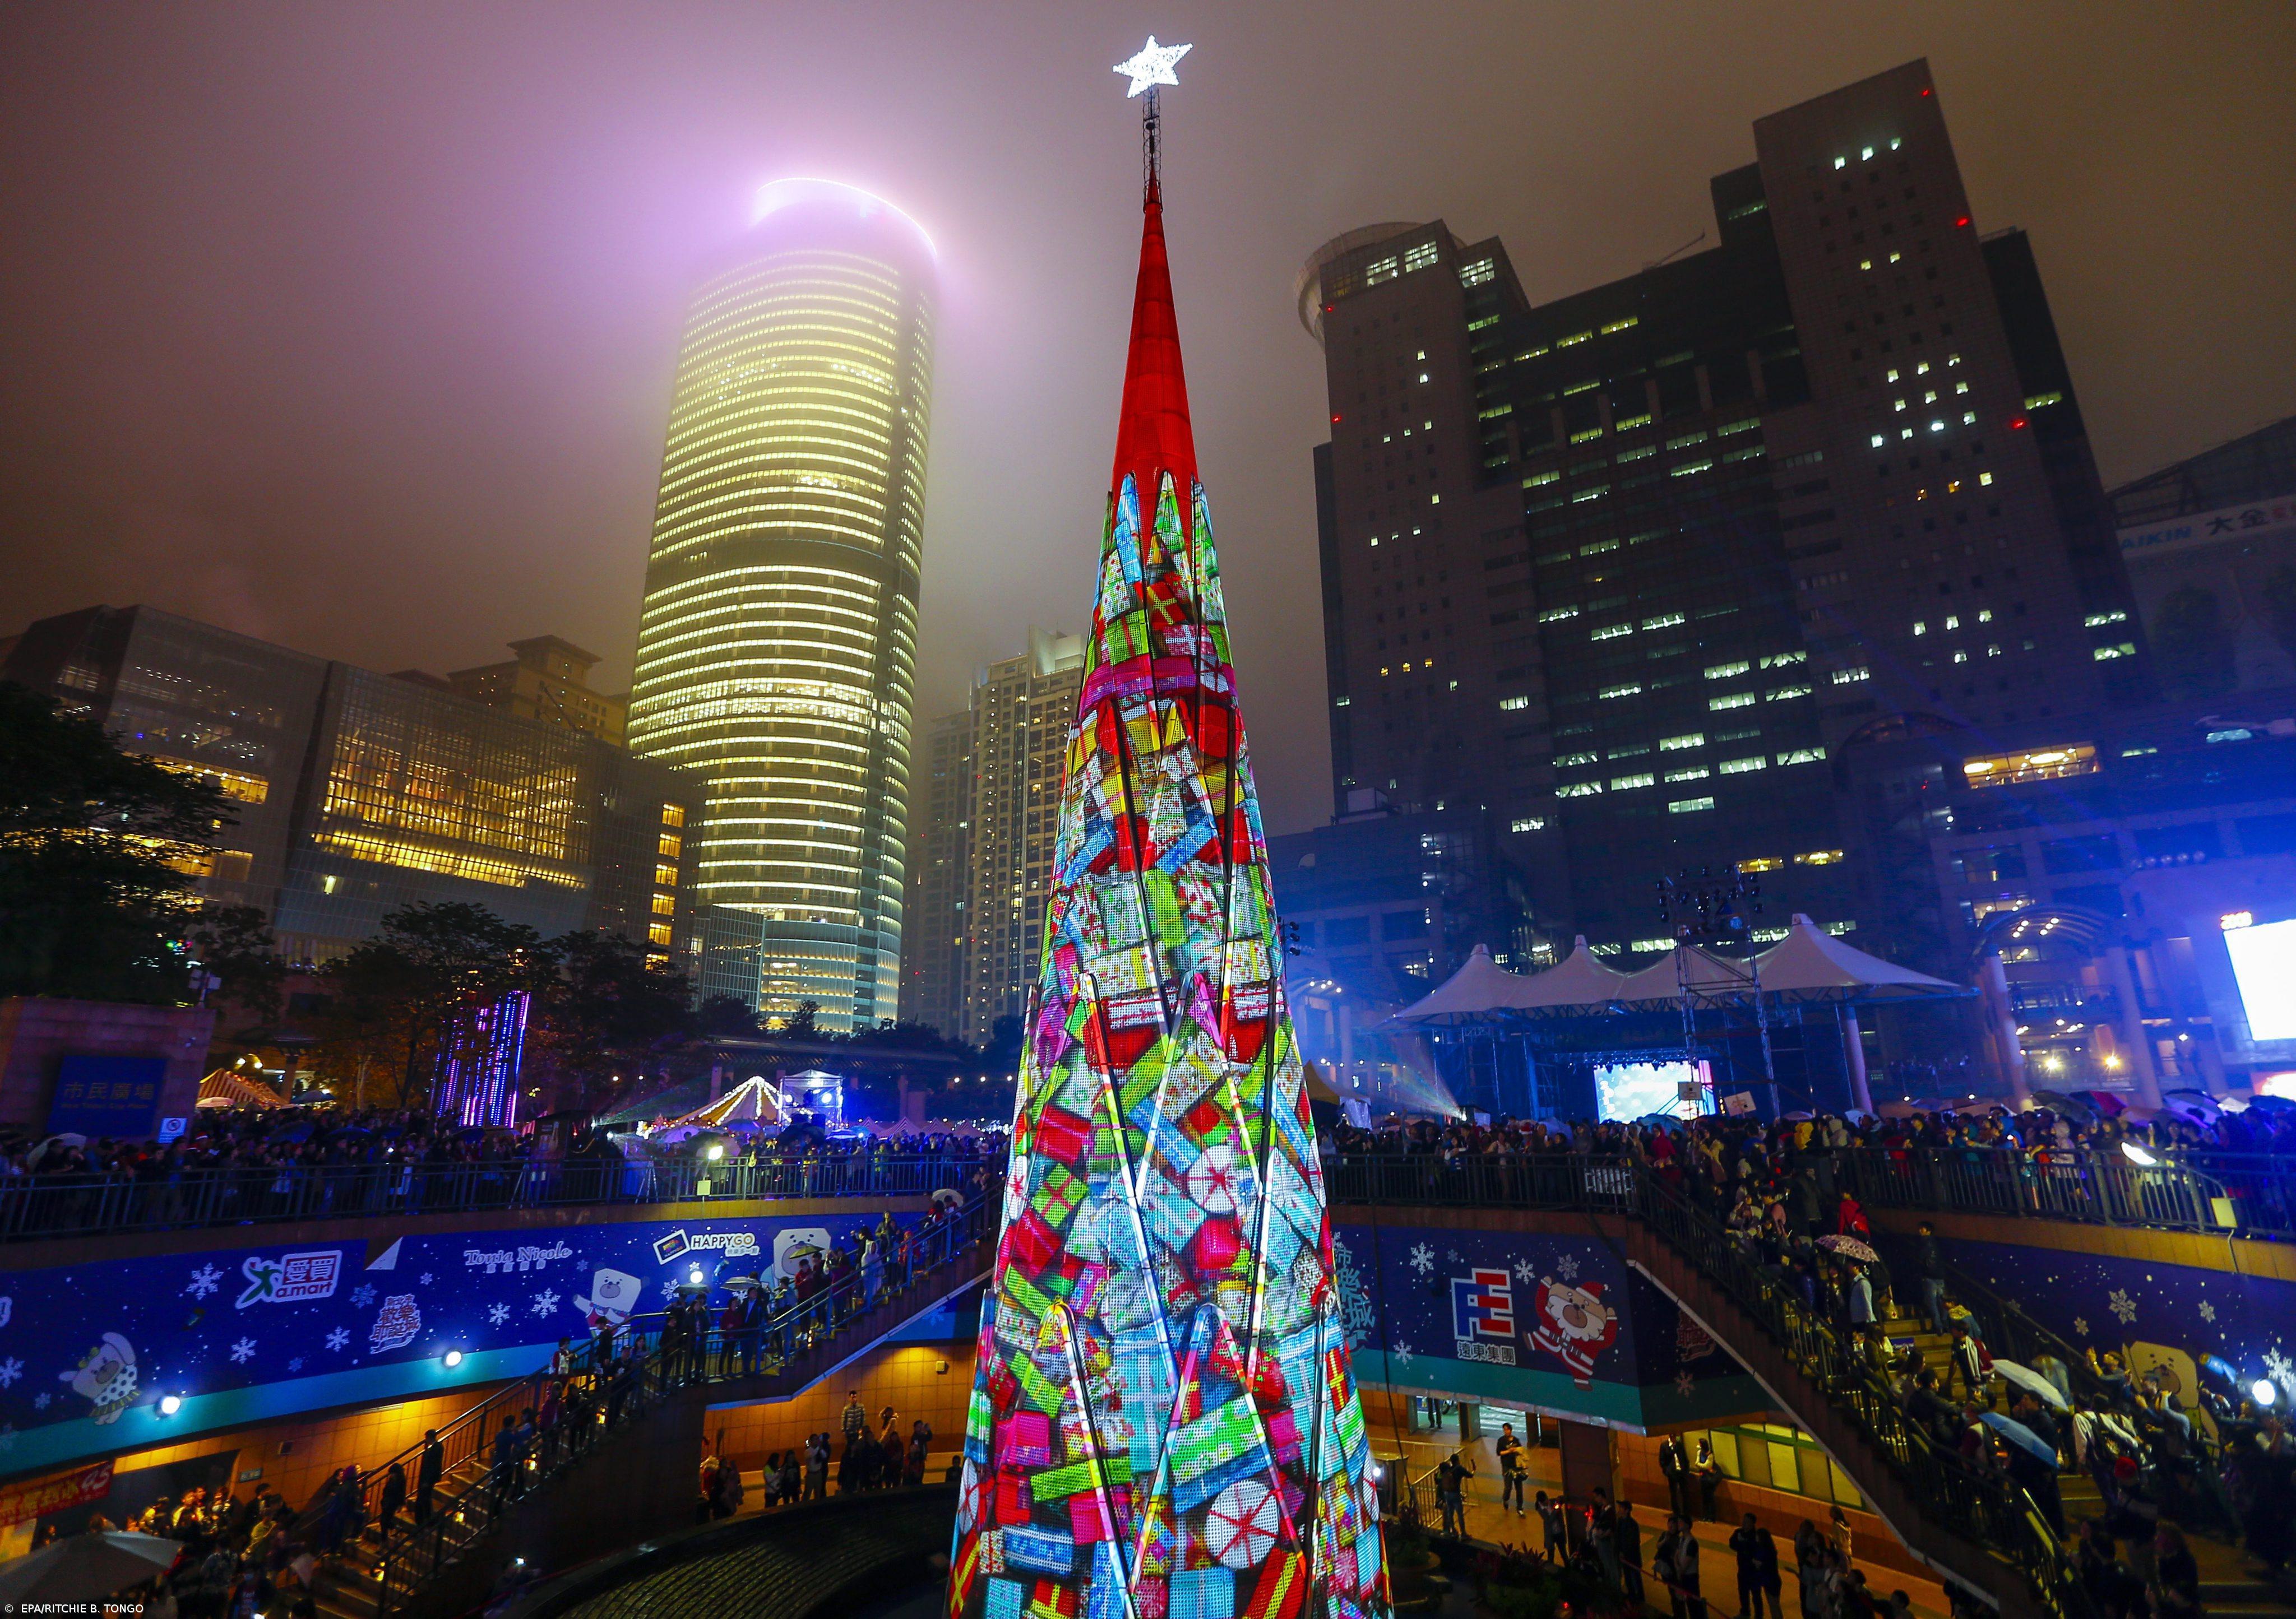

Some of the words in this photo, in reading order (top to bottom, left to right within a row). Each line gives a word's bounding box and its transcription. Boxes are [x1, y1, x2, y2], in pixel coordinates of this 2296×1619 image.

[2122, 527, 2192, 548] AIKIN
[693, 1235, 753, 1247] HAPPYGO
[464, 1250, 513, 1265] Tonia
[516, 1241, 572, 1261] Nicole
[1458, 1341, 1516, 1365] 遠東集團
